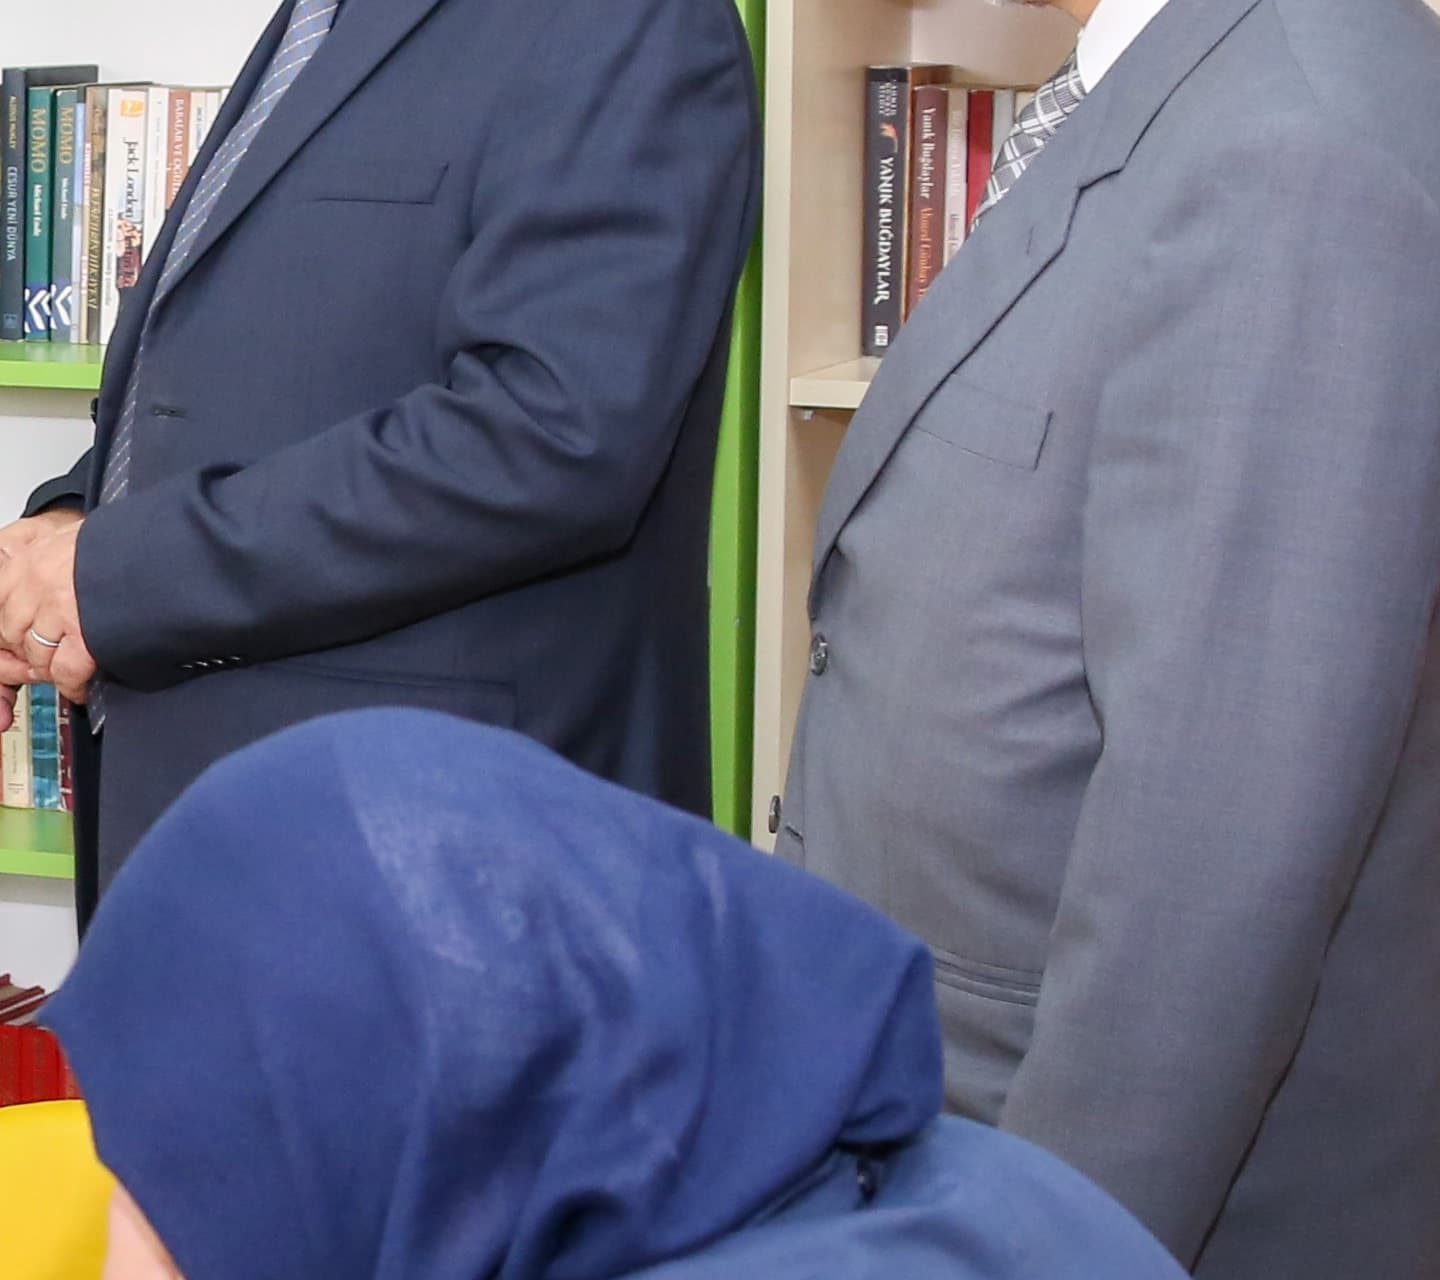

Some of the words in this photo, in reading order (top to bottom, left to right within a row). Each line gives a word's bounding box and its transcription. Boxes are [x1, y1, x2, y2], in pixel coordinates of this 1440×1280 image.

[31, 108, 47, 173] MOMO
[59, 106, 74, 164] MOMO
[921, 109, 936, 139] Yanık
[7, 167, 18, 198] CESUR
[123, 167, 140, 218] London
[879, 156, 894, 203] YANIK
[7, 200, 19, 224] YENİ
[6, 227, 18, 260] DÜNYA
[874, 209, 894, 304] BUĞDAYLAR
